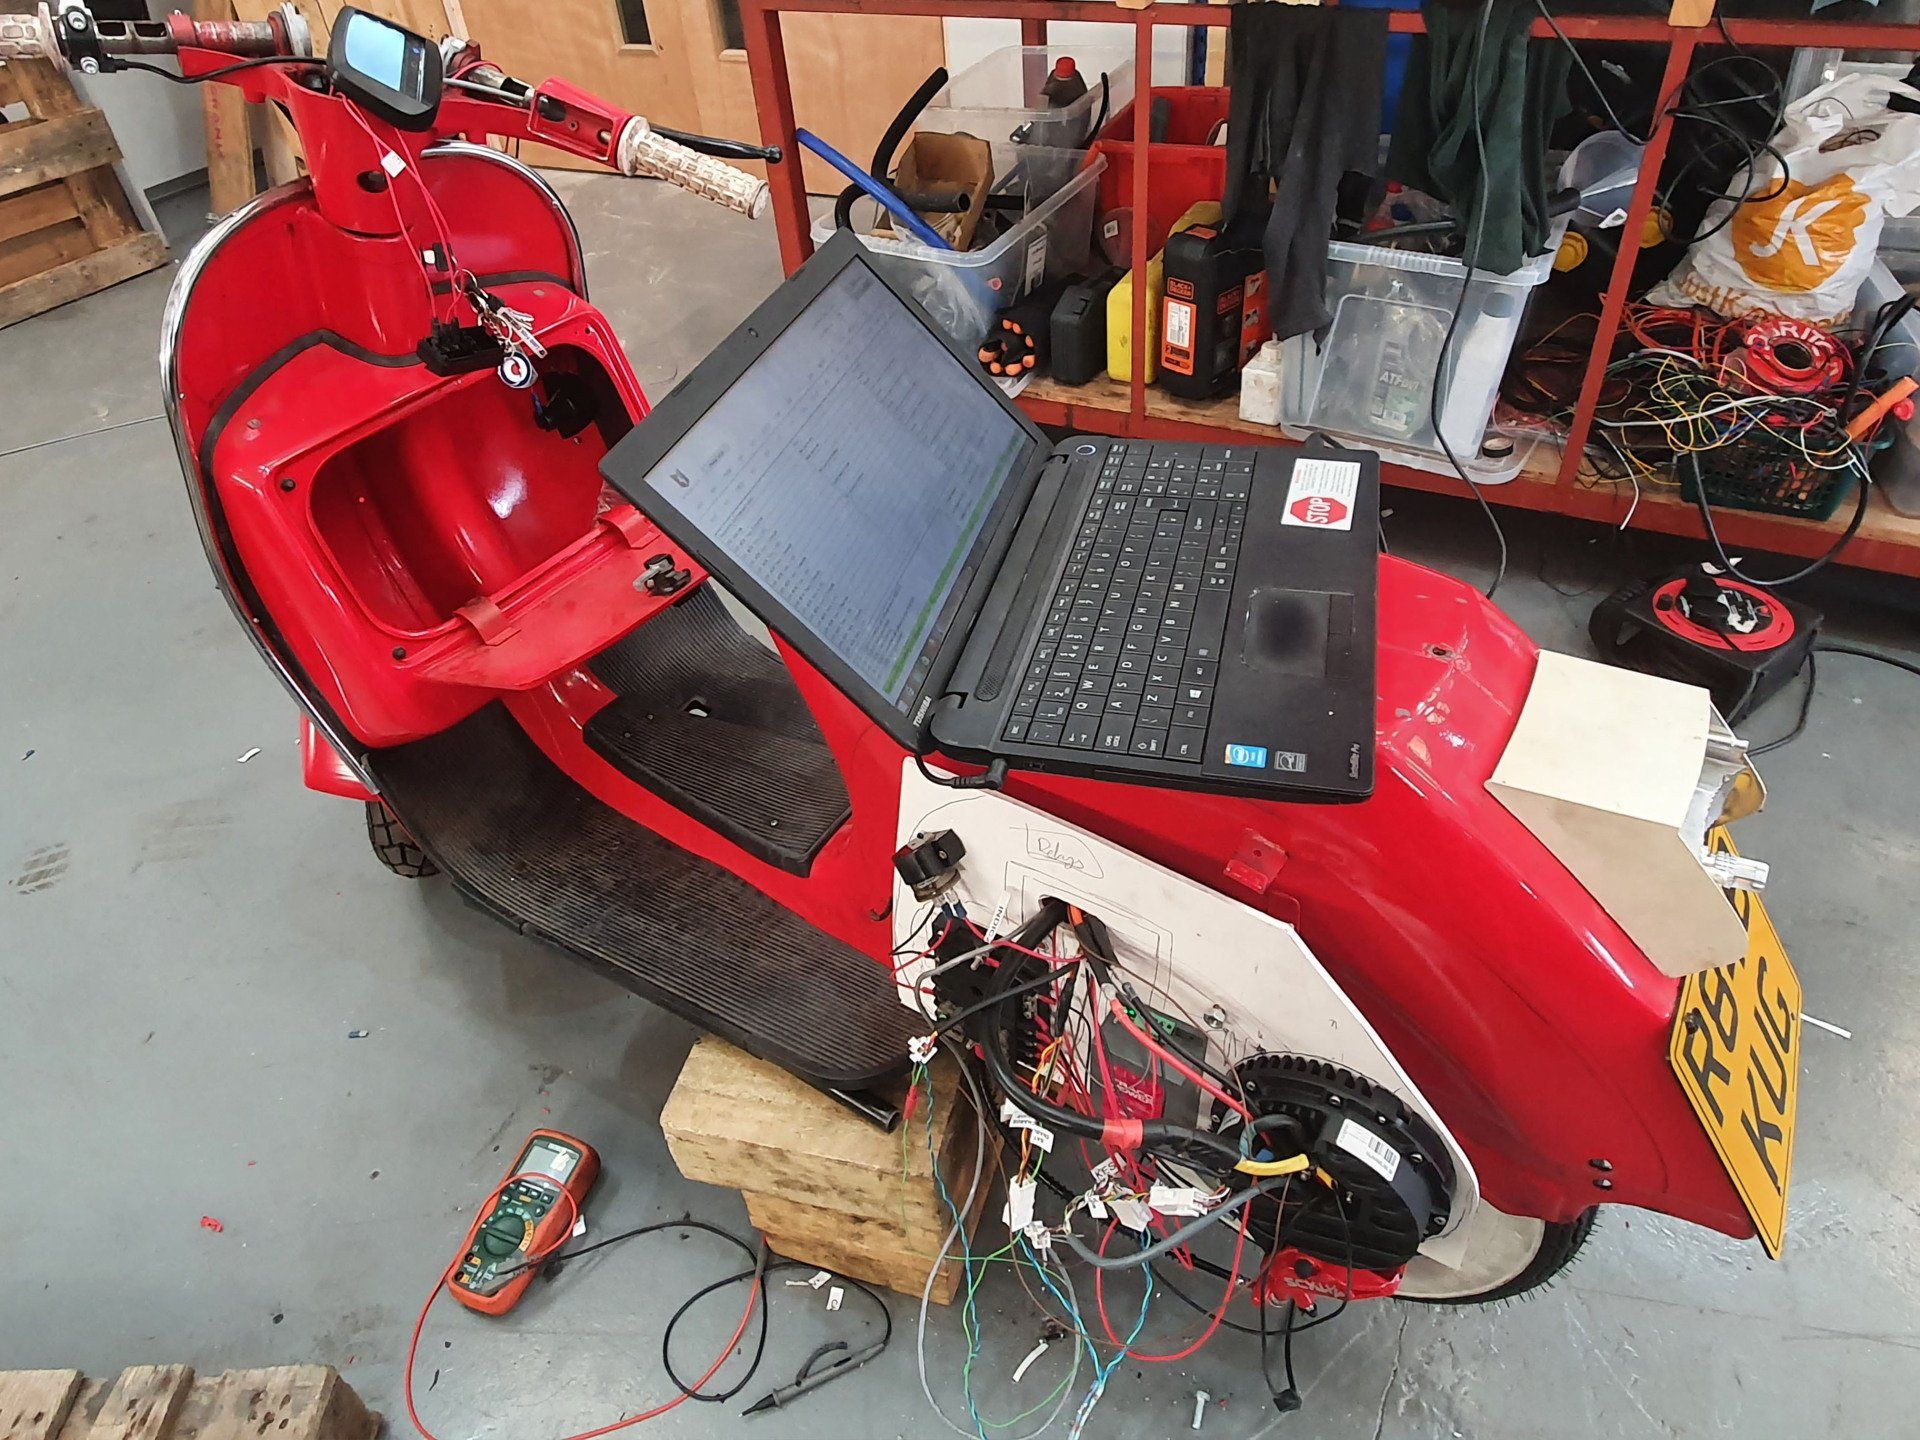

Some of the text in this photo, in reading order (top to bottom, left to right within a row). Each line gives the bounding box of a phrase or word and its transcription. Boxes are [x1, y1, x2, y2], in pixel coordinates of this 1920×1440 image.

[1305, 497, 1332, 525] STOP
[1173, 583, 1185, 591] M
[1169, 600, 1181, 608] N
[1122, 661, 1133, 669] D
[1152, 674, 1164, 682] X
[1117, 681, 1128, 689] S
[1076, 701, 1088, 710] Q
[1082, 679, 1094, 690] W
[1147, 694, 1159, 703] Z
[1111, 701, 1122, 709] A
[912, 695, 932, 728] TOSHIBA
[1741, 955, 1793, 1197] KUG
